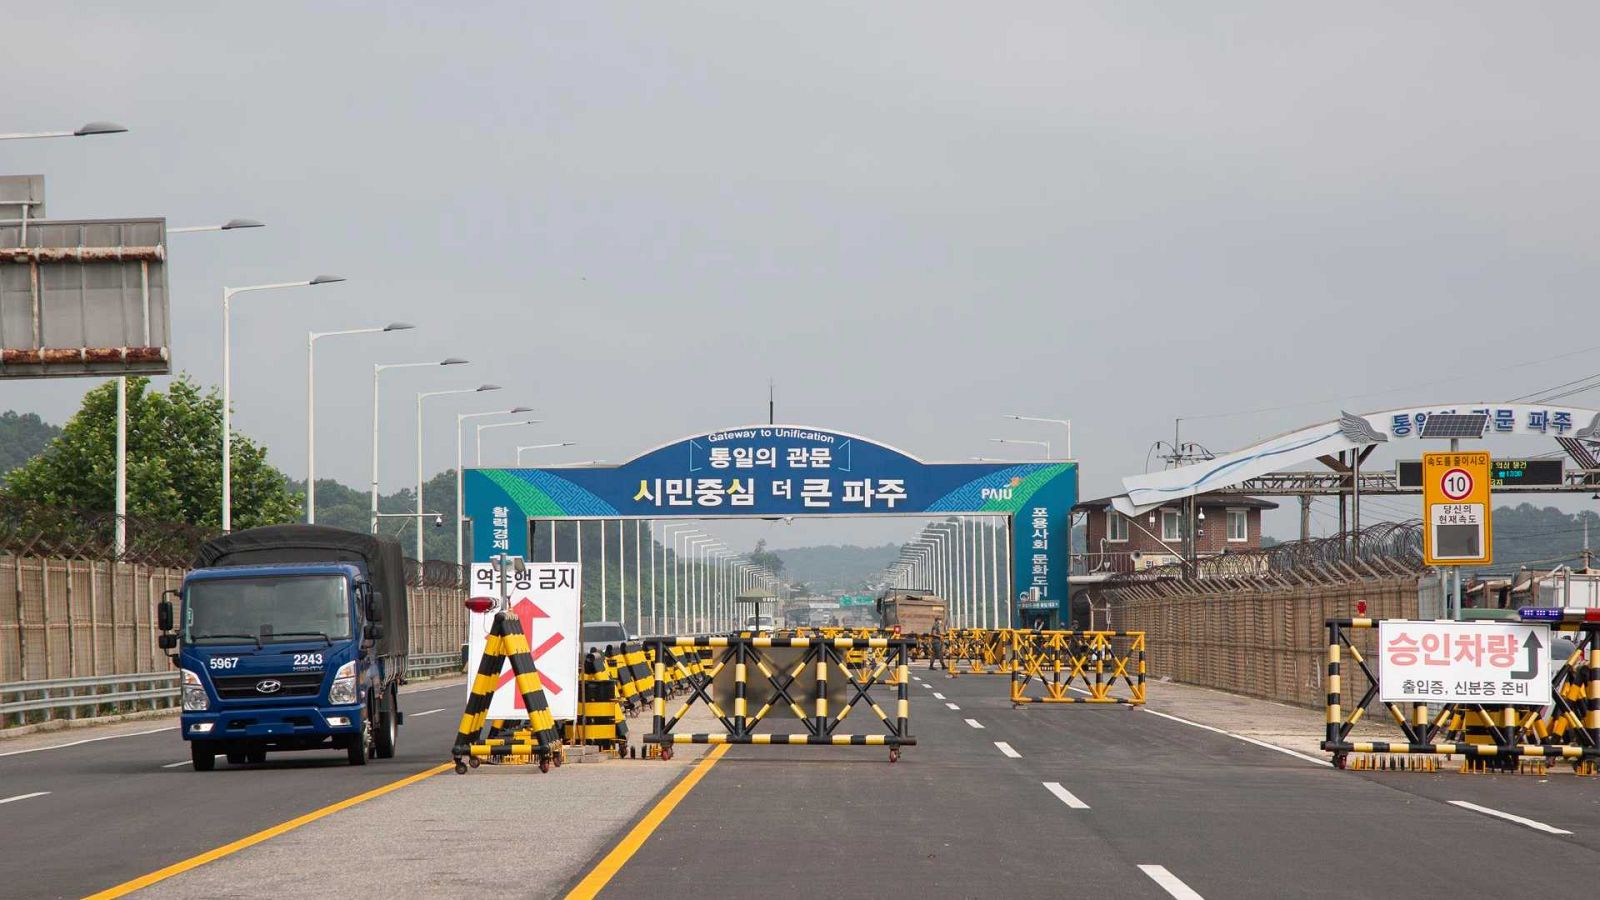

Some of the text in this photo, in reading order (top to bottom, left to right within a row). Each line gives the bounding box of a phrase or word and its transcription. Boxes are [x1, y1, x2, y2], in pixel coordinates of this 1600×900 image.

[1528, 409, 1572, 433] 파주
[708, 428, 834, 444] Gateway to Unification
[709, 446, 833, 468] 통일의 관문
[1427, 456, 1486, 467] 속도를 줄이시오
[1447, 476, 1466, 492] 10
[633, 478, 908, 508] 시민중심 더 큰 파주
[982, 488, 1012, 501] PAJU
[1443, 505, 1472, 514] 당신의
[1439, 514, 1478, 524] 현재속도
[1032, 508, 1049, 550] 포용사회
[539, 568, 575, 590] 금지
[1388, 633, 1518, 668] 승인차량
[210, 654, 323, 670] 5967 2243
[1402, 679, 1528, 697] 출입증, 신분증 준비
